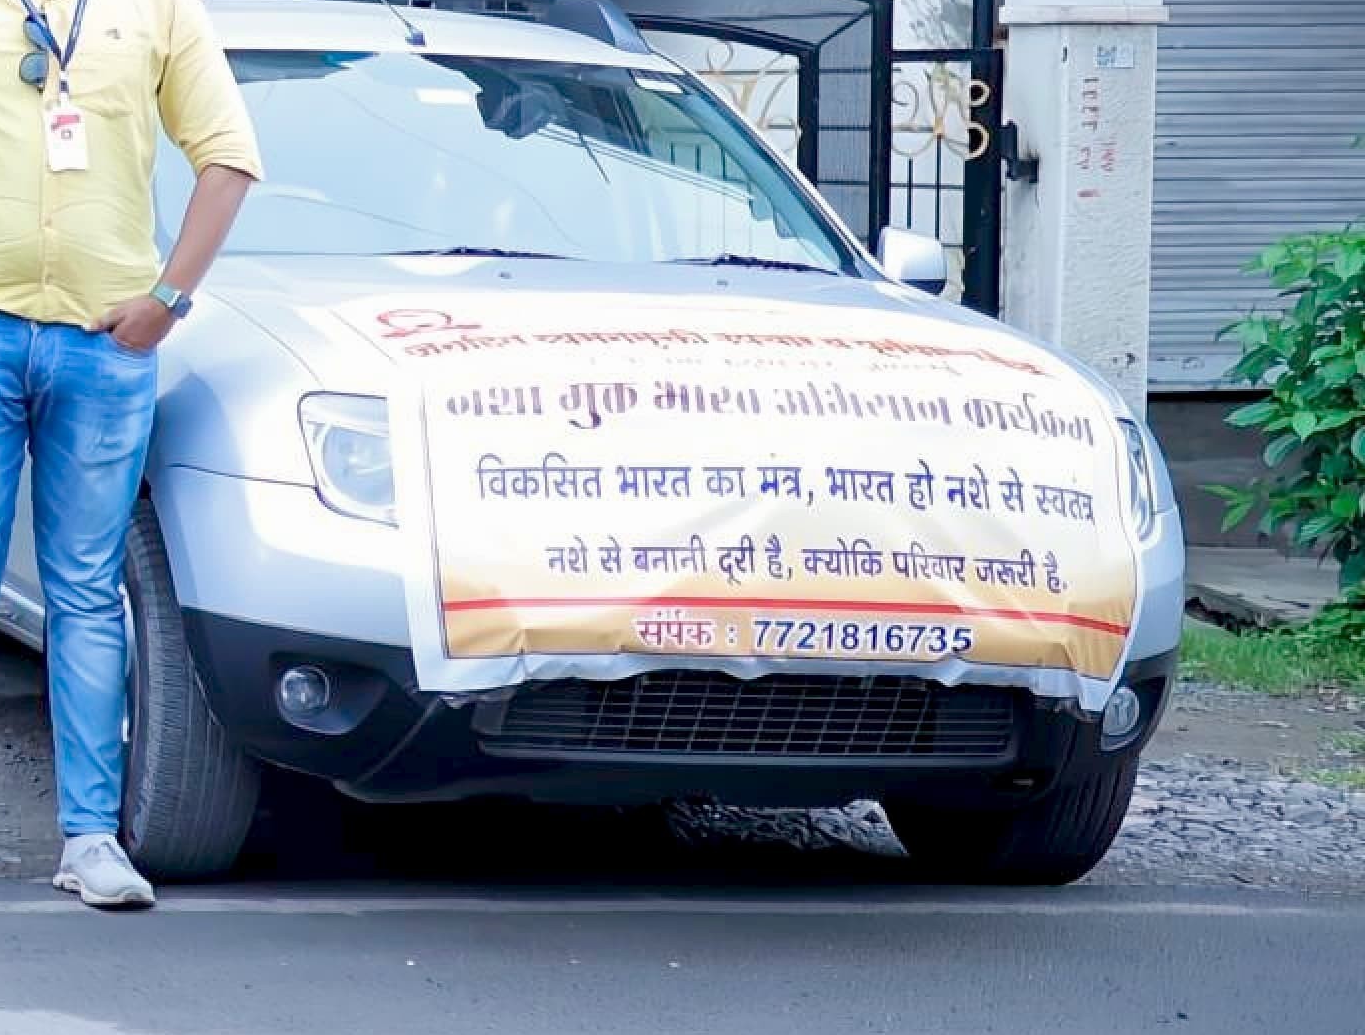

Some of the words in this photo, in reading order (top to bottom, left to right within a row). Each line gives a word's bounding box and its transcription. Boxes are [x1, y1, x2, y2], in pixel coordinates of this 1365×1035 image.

[476, 451, 605, 499] विकसित
[615, 465, 693, 499] भारत
[702, 466, 746, 499] का
[824, 465, 896, 505] भारत
[904, 458, 935, 511] हो
[944, 462, 991, 511] नशे
[999, 465, 1025, 515] से
[545, 535, 588, 575] नशे
[598, 535, 622, 573] से
[631, 533, 709, 575] बनानी
[716, 533, 755, 587] दूरी
[891, 540, 967, 585] परिवार
[753, 619, 973, 655] 7721816735
